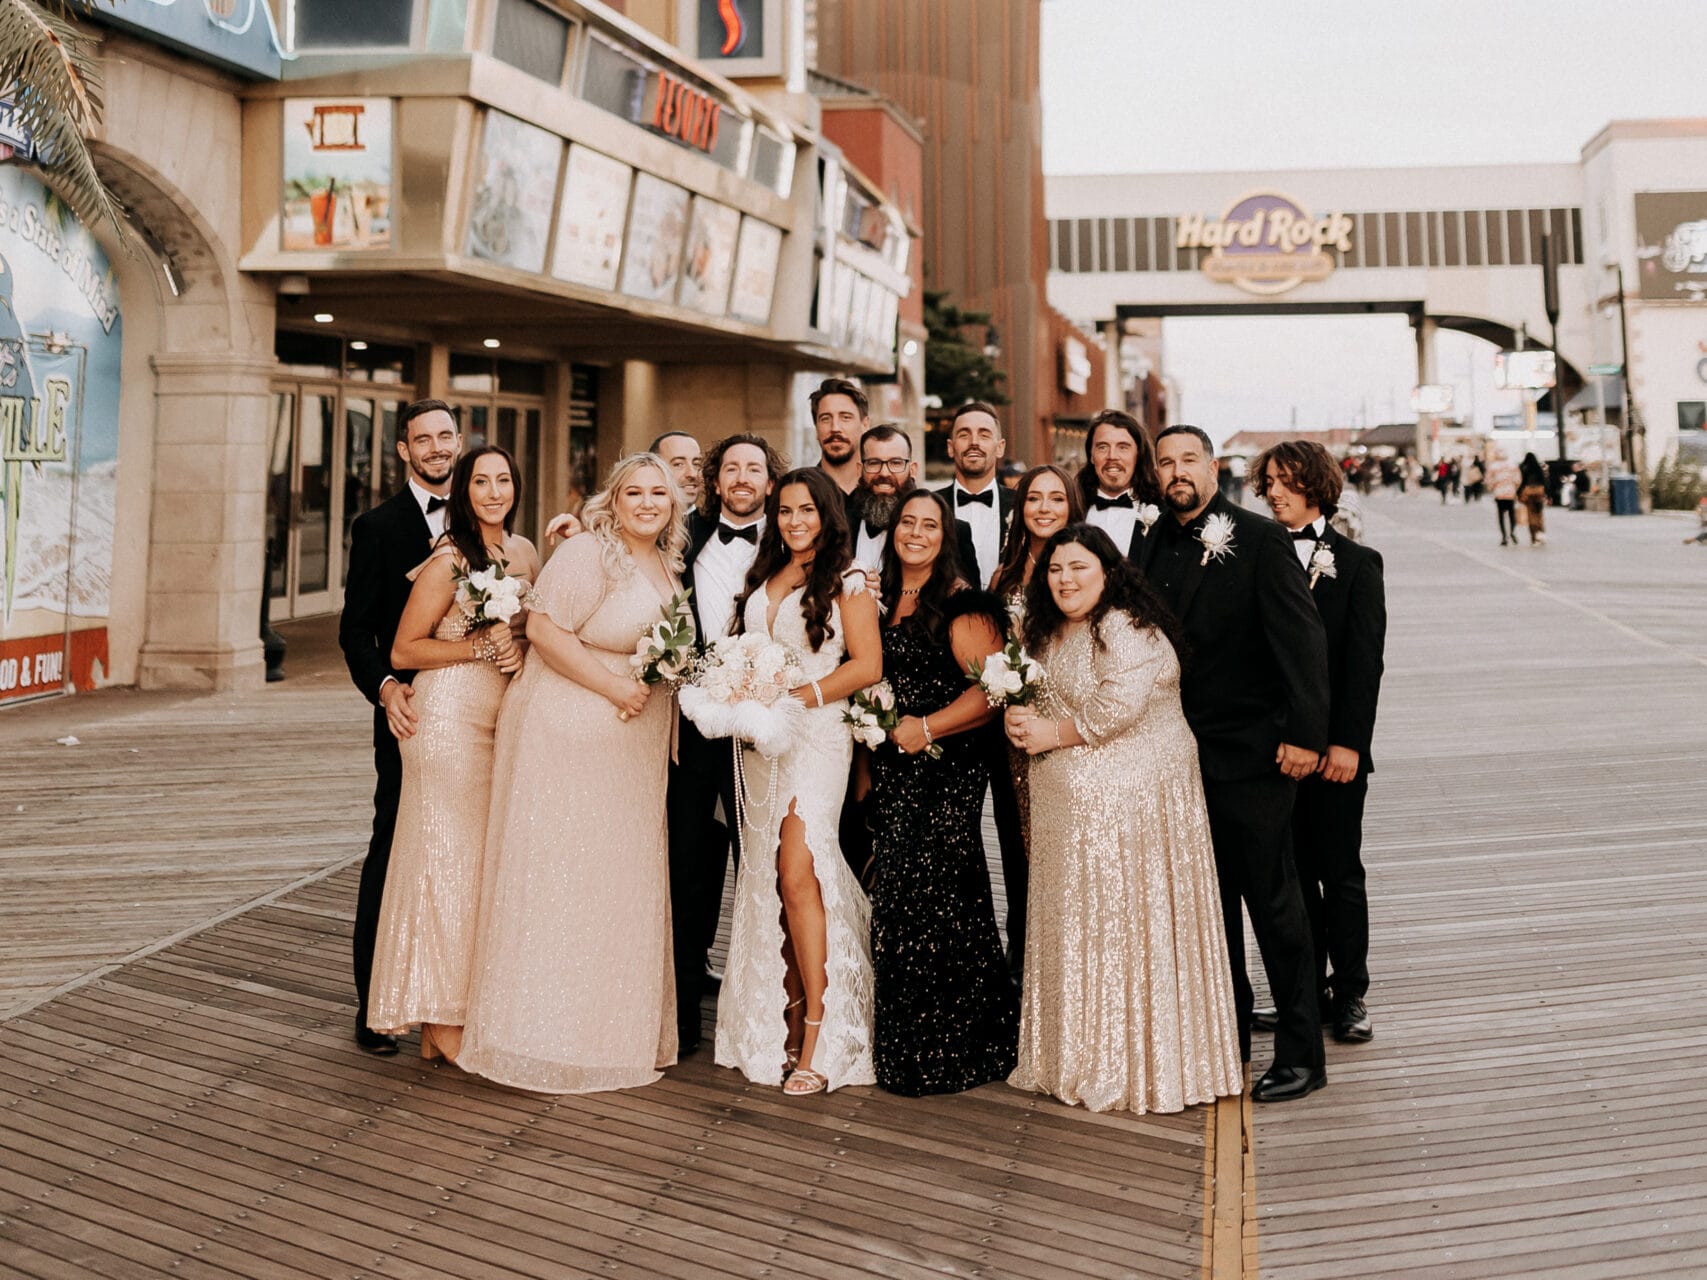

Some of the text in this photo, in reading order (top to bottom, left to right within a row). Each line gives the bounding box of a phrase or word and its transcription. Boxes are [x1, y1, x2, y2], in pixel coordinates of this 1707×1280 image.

[1177, 207, 1353, 254] Hard Rock
[20, 655, 32, 687] &
[34, 651, 63, 685] FUN!
